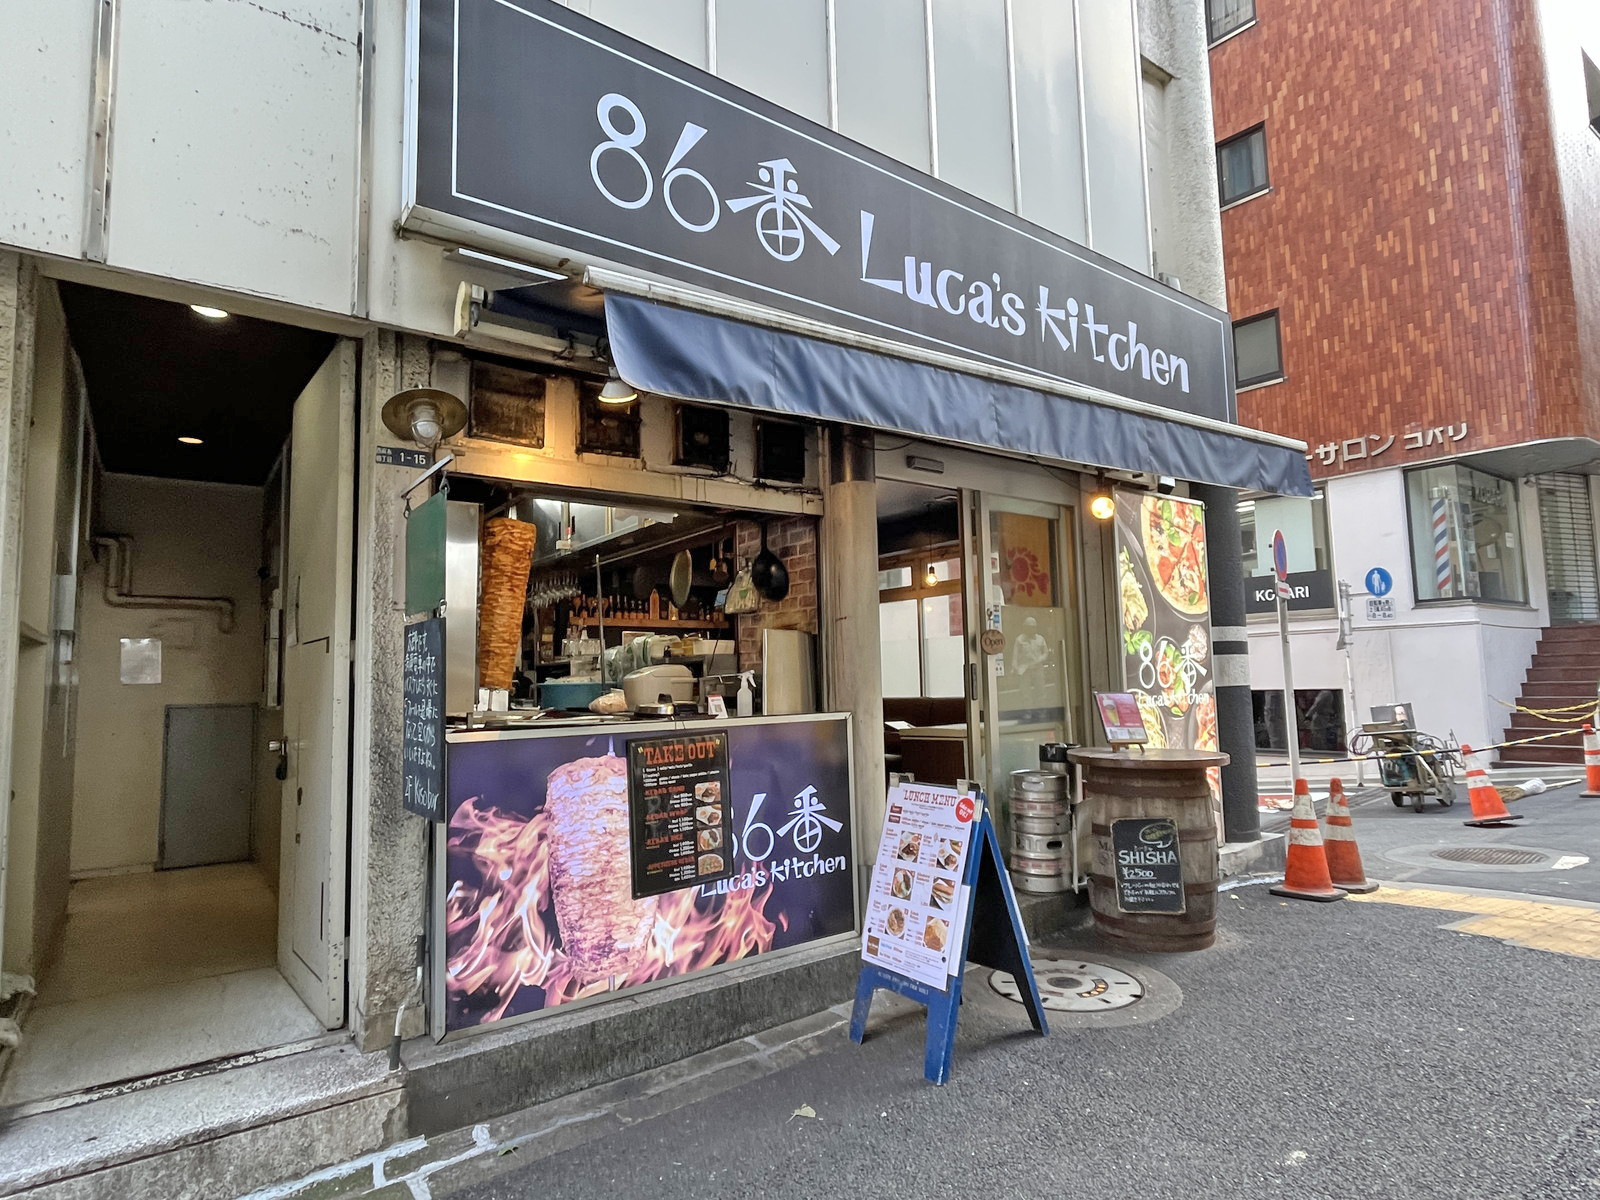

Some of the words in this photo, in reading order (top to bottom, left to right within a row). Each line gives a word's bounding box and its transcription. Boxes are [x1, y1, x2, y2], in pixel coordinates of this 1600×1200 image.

[590, 93, 840, 262] 86番
[860, 210, 1026, 336] Luca's
[1035, 286, 1190, 394] kitchen
[1305, 435, 1396, 466] サロン
[1255, 586, 1310, 602] KOARI
[984, 637, 1004, 649] Open
[904, 789, 931, 804] LUNCH
[931, 793, 957, 807] MENU
[731, 784, 844, 862] 6番
[770, 853, 846, 883] kitchen
[1118, 850, 1178, 865] SHISHA
